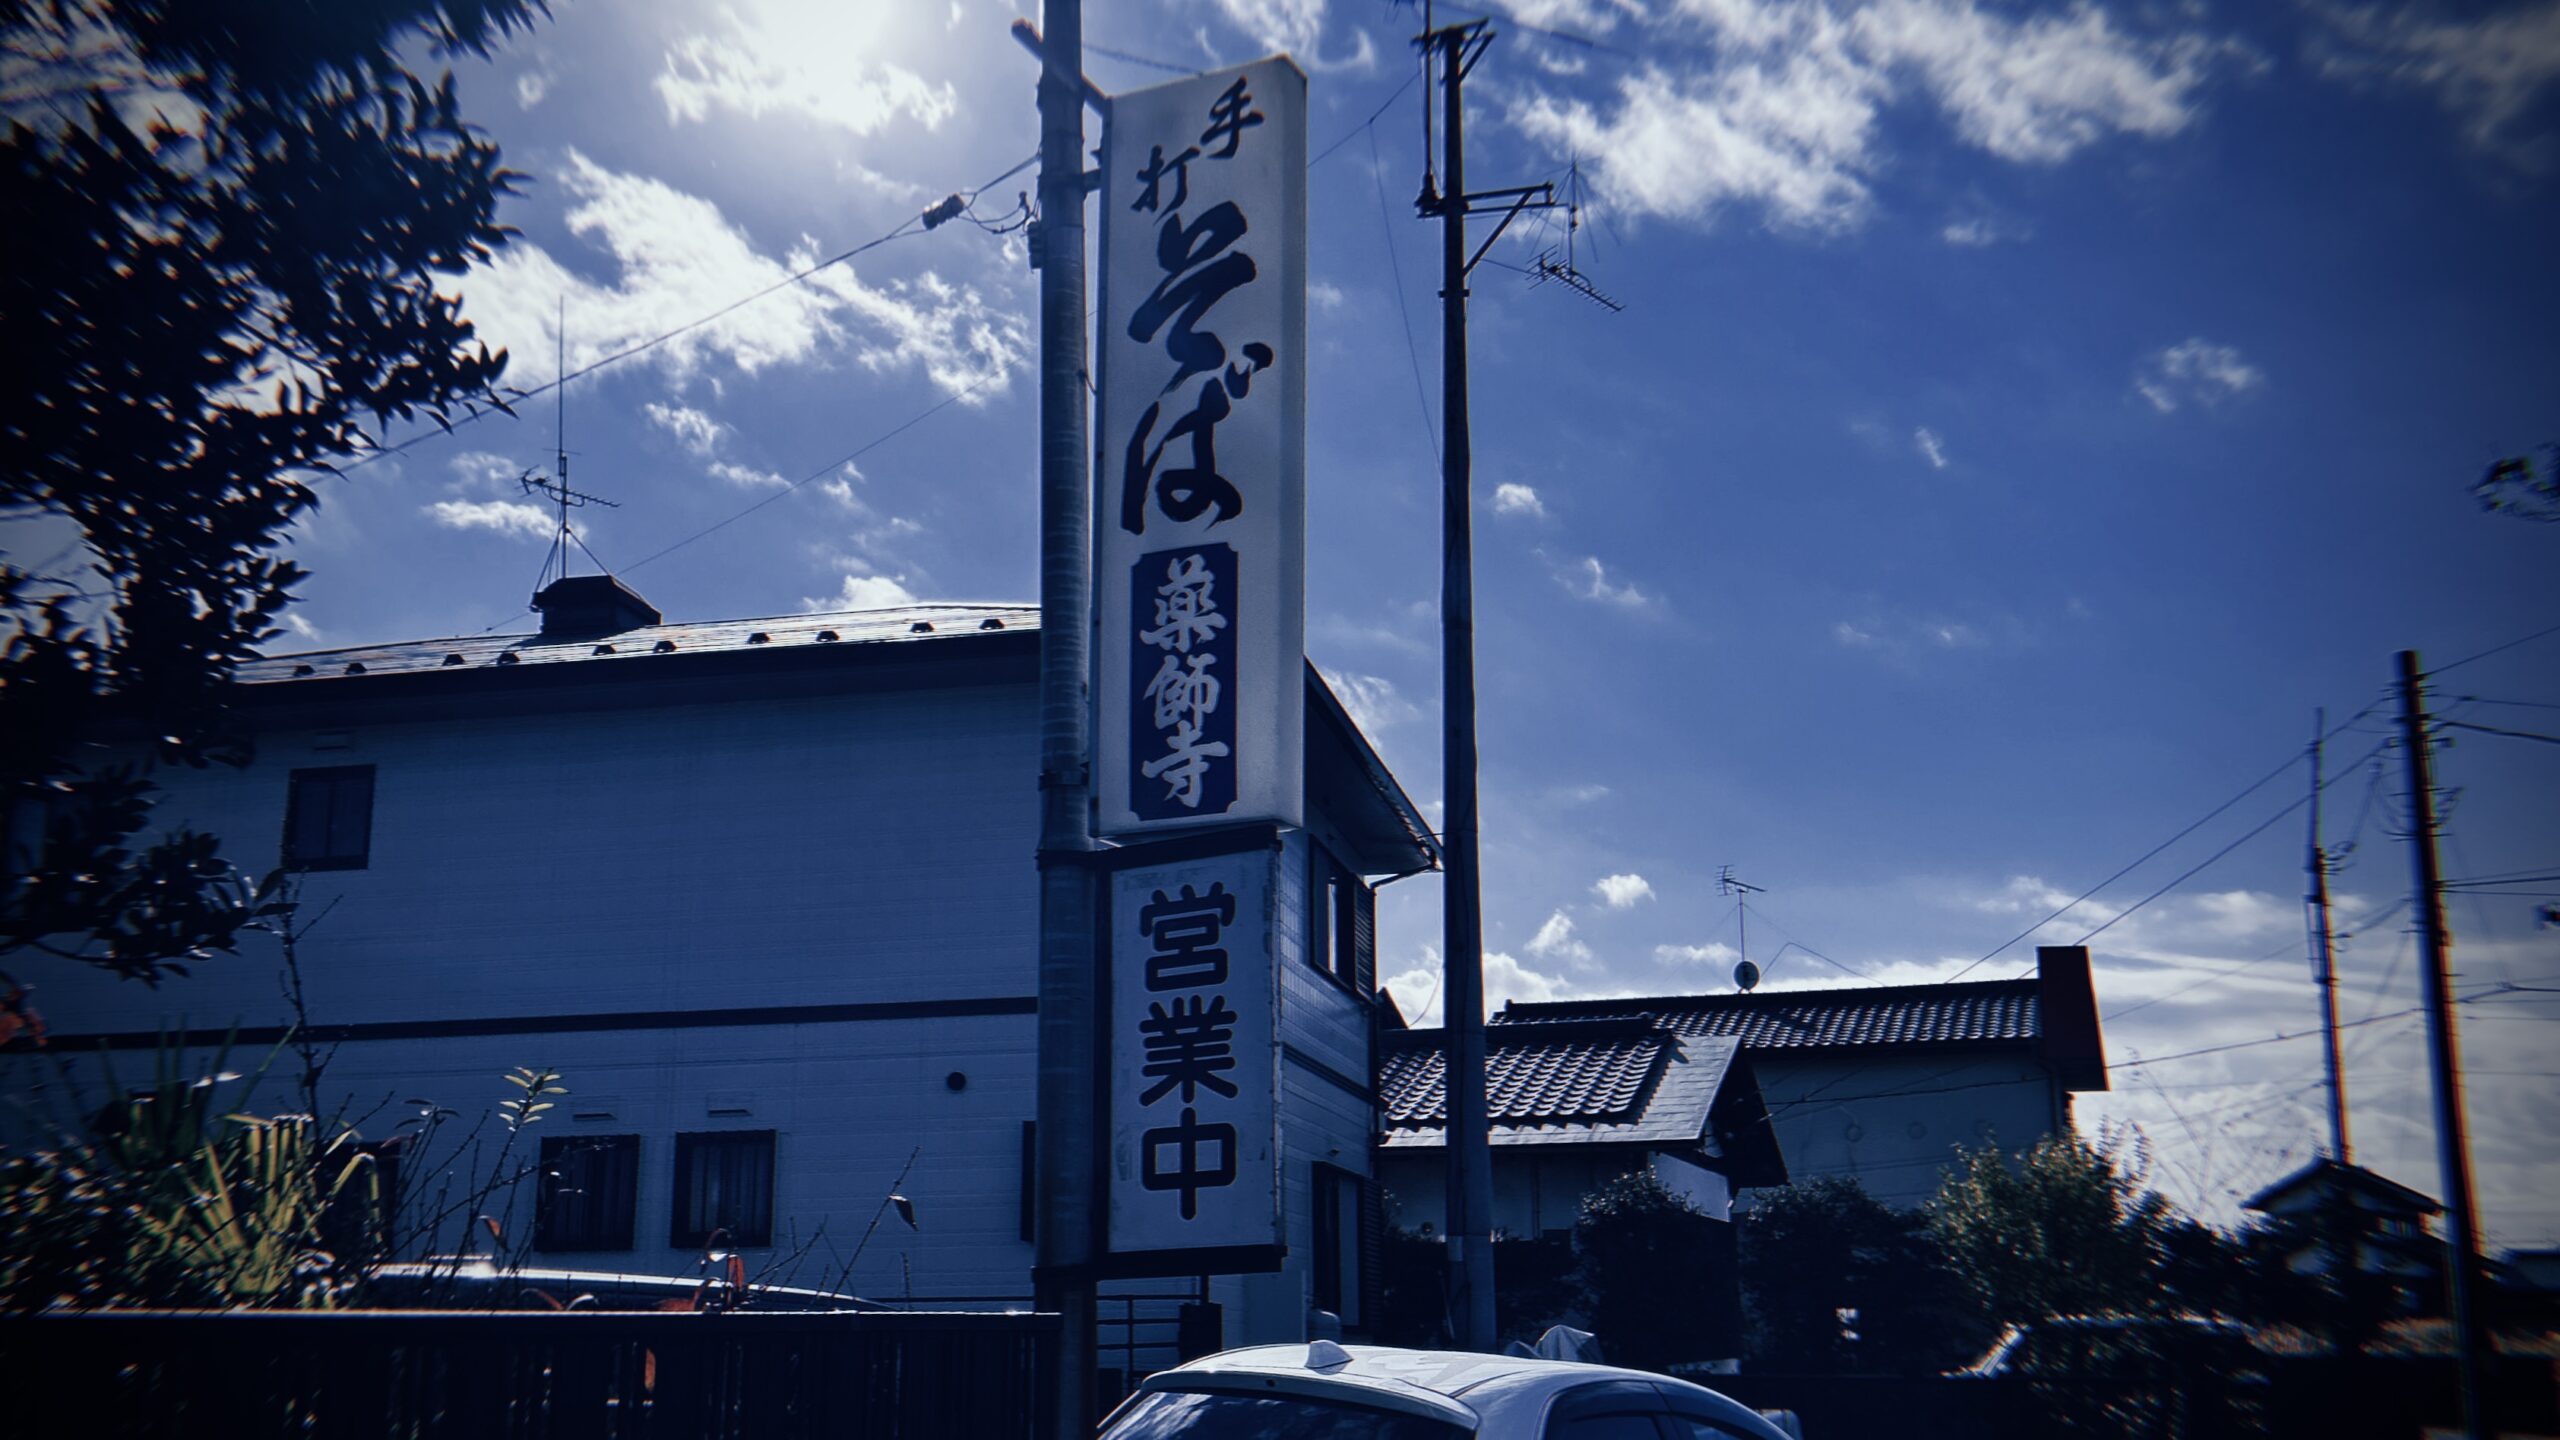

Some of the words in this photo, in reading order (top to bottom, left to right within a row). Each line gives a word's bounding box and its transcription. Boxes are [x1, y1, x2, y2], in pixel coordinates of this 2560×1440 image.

[1139, 553, 1231, 808] 薬師寺
[1139, 882, 1238, 1220] 営業中
